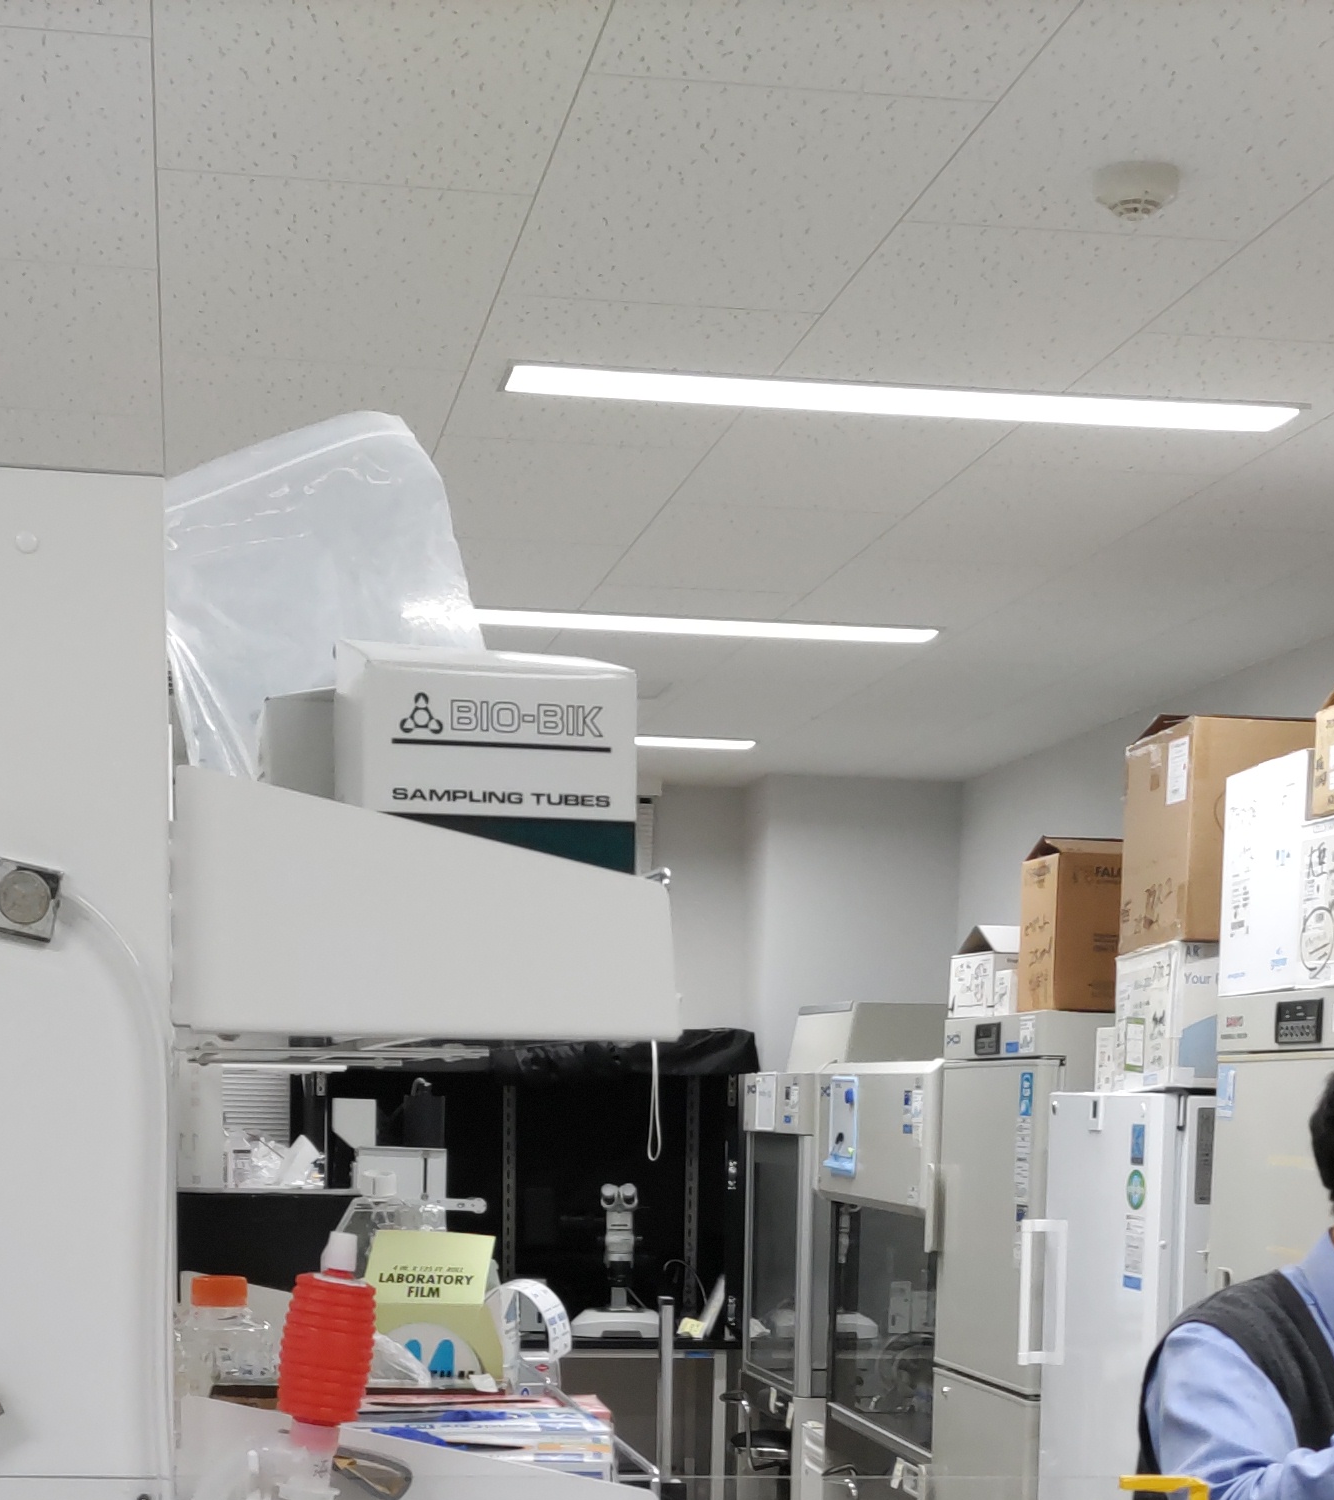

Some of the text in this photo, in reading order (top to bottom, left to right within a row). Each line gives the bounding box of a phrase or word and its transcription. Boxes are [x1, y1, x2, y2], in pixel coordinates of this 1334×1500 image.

[450, 699, 604, 738] BIO-BIK
[392, 787, 611, 808] SAMPLING TUBES
[1183, 972, 1212, 985] Your
[378, 1272, 475, 1286] LABORATORY
[407, 1286, 441, 1298] FILM
